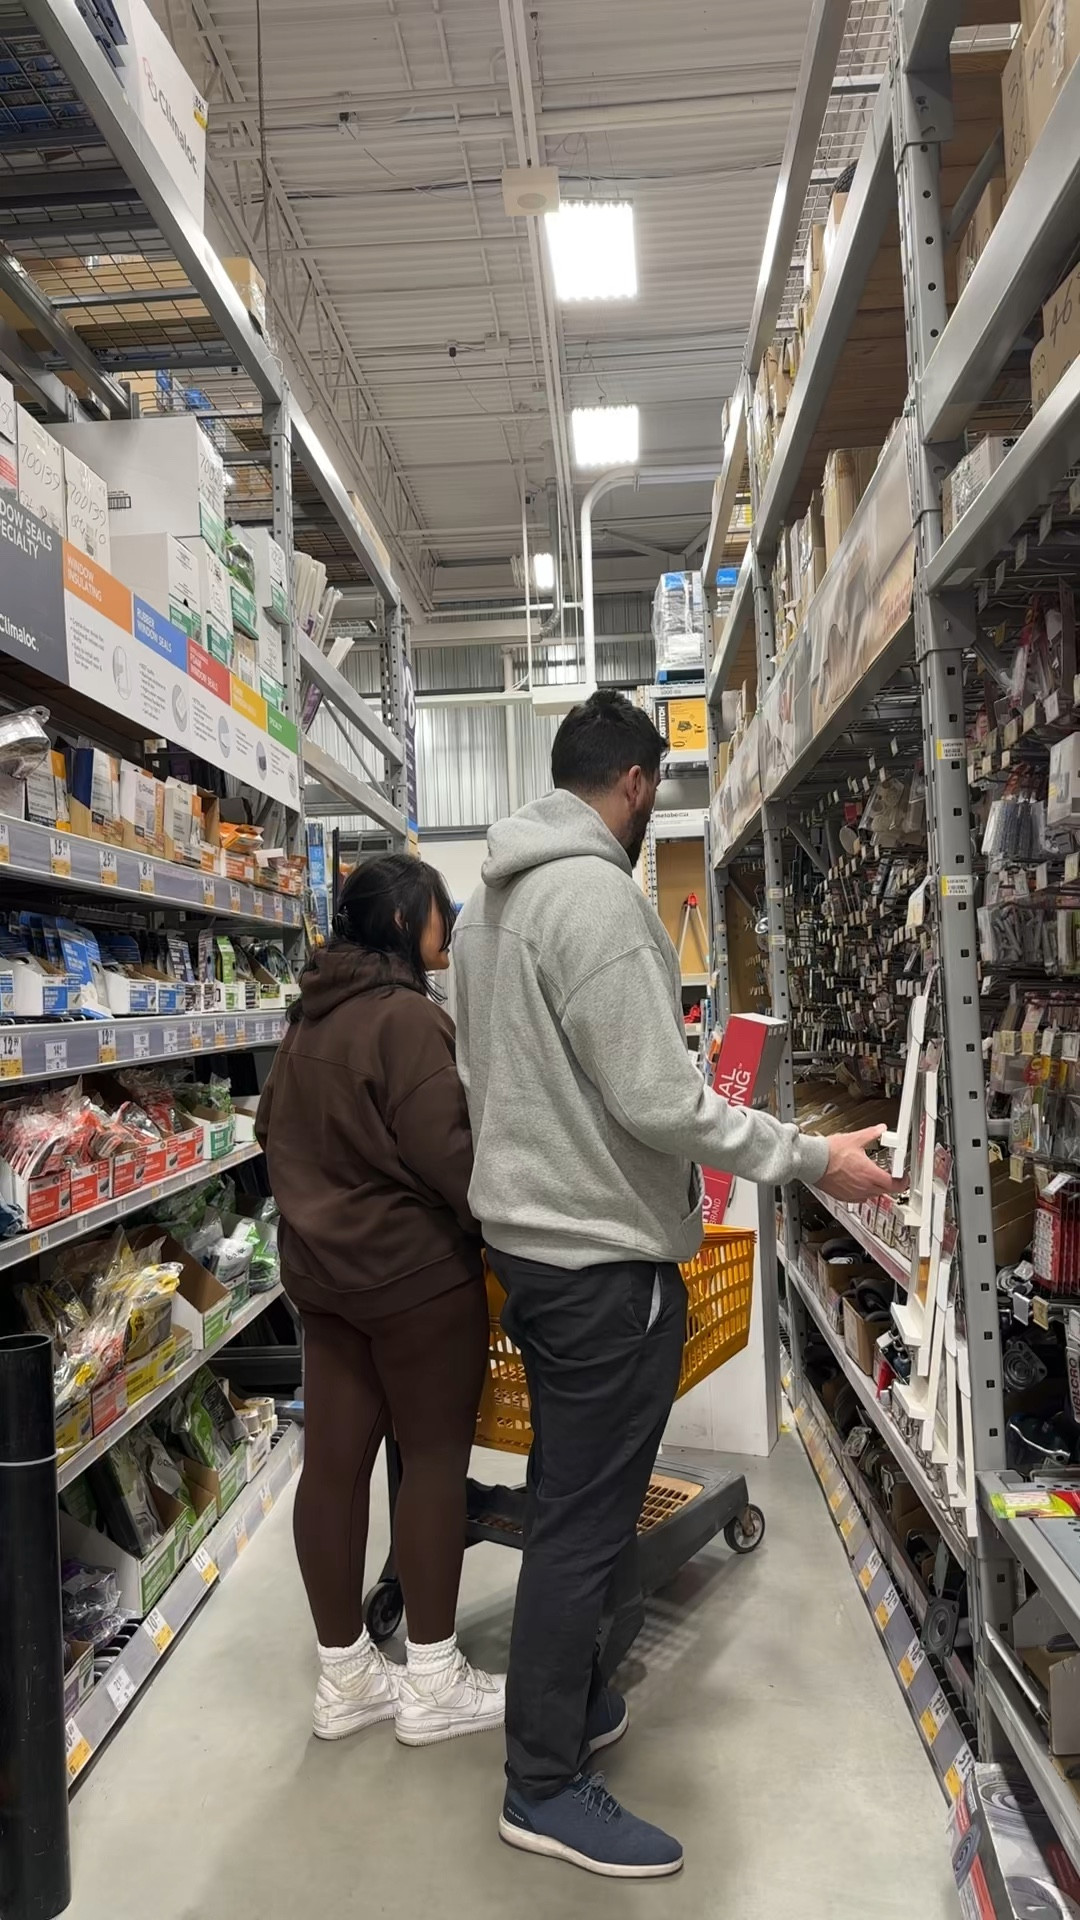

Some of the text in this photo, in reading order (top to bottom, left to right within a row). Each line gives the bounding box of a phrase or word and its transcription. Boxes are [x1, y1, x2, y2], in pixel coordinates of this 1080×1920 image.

[159, 89, 198, 175] Climaloc
[0, 518, 39, 559] ECIALTY
[26, 519, 52, 552] SEALS
[67, 555, 95, 583] WINDOW
[67, 568, 102, 602] INSULATING
[658, 706, 667, 739] OSTITCH
[708, 1197, 721, 1225] BRAND
